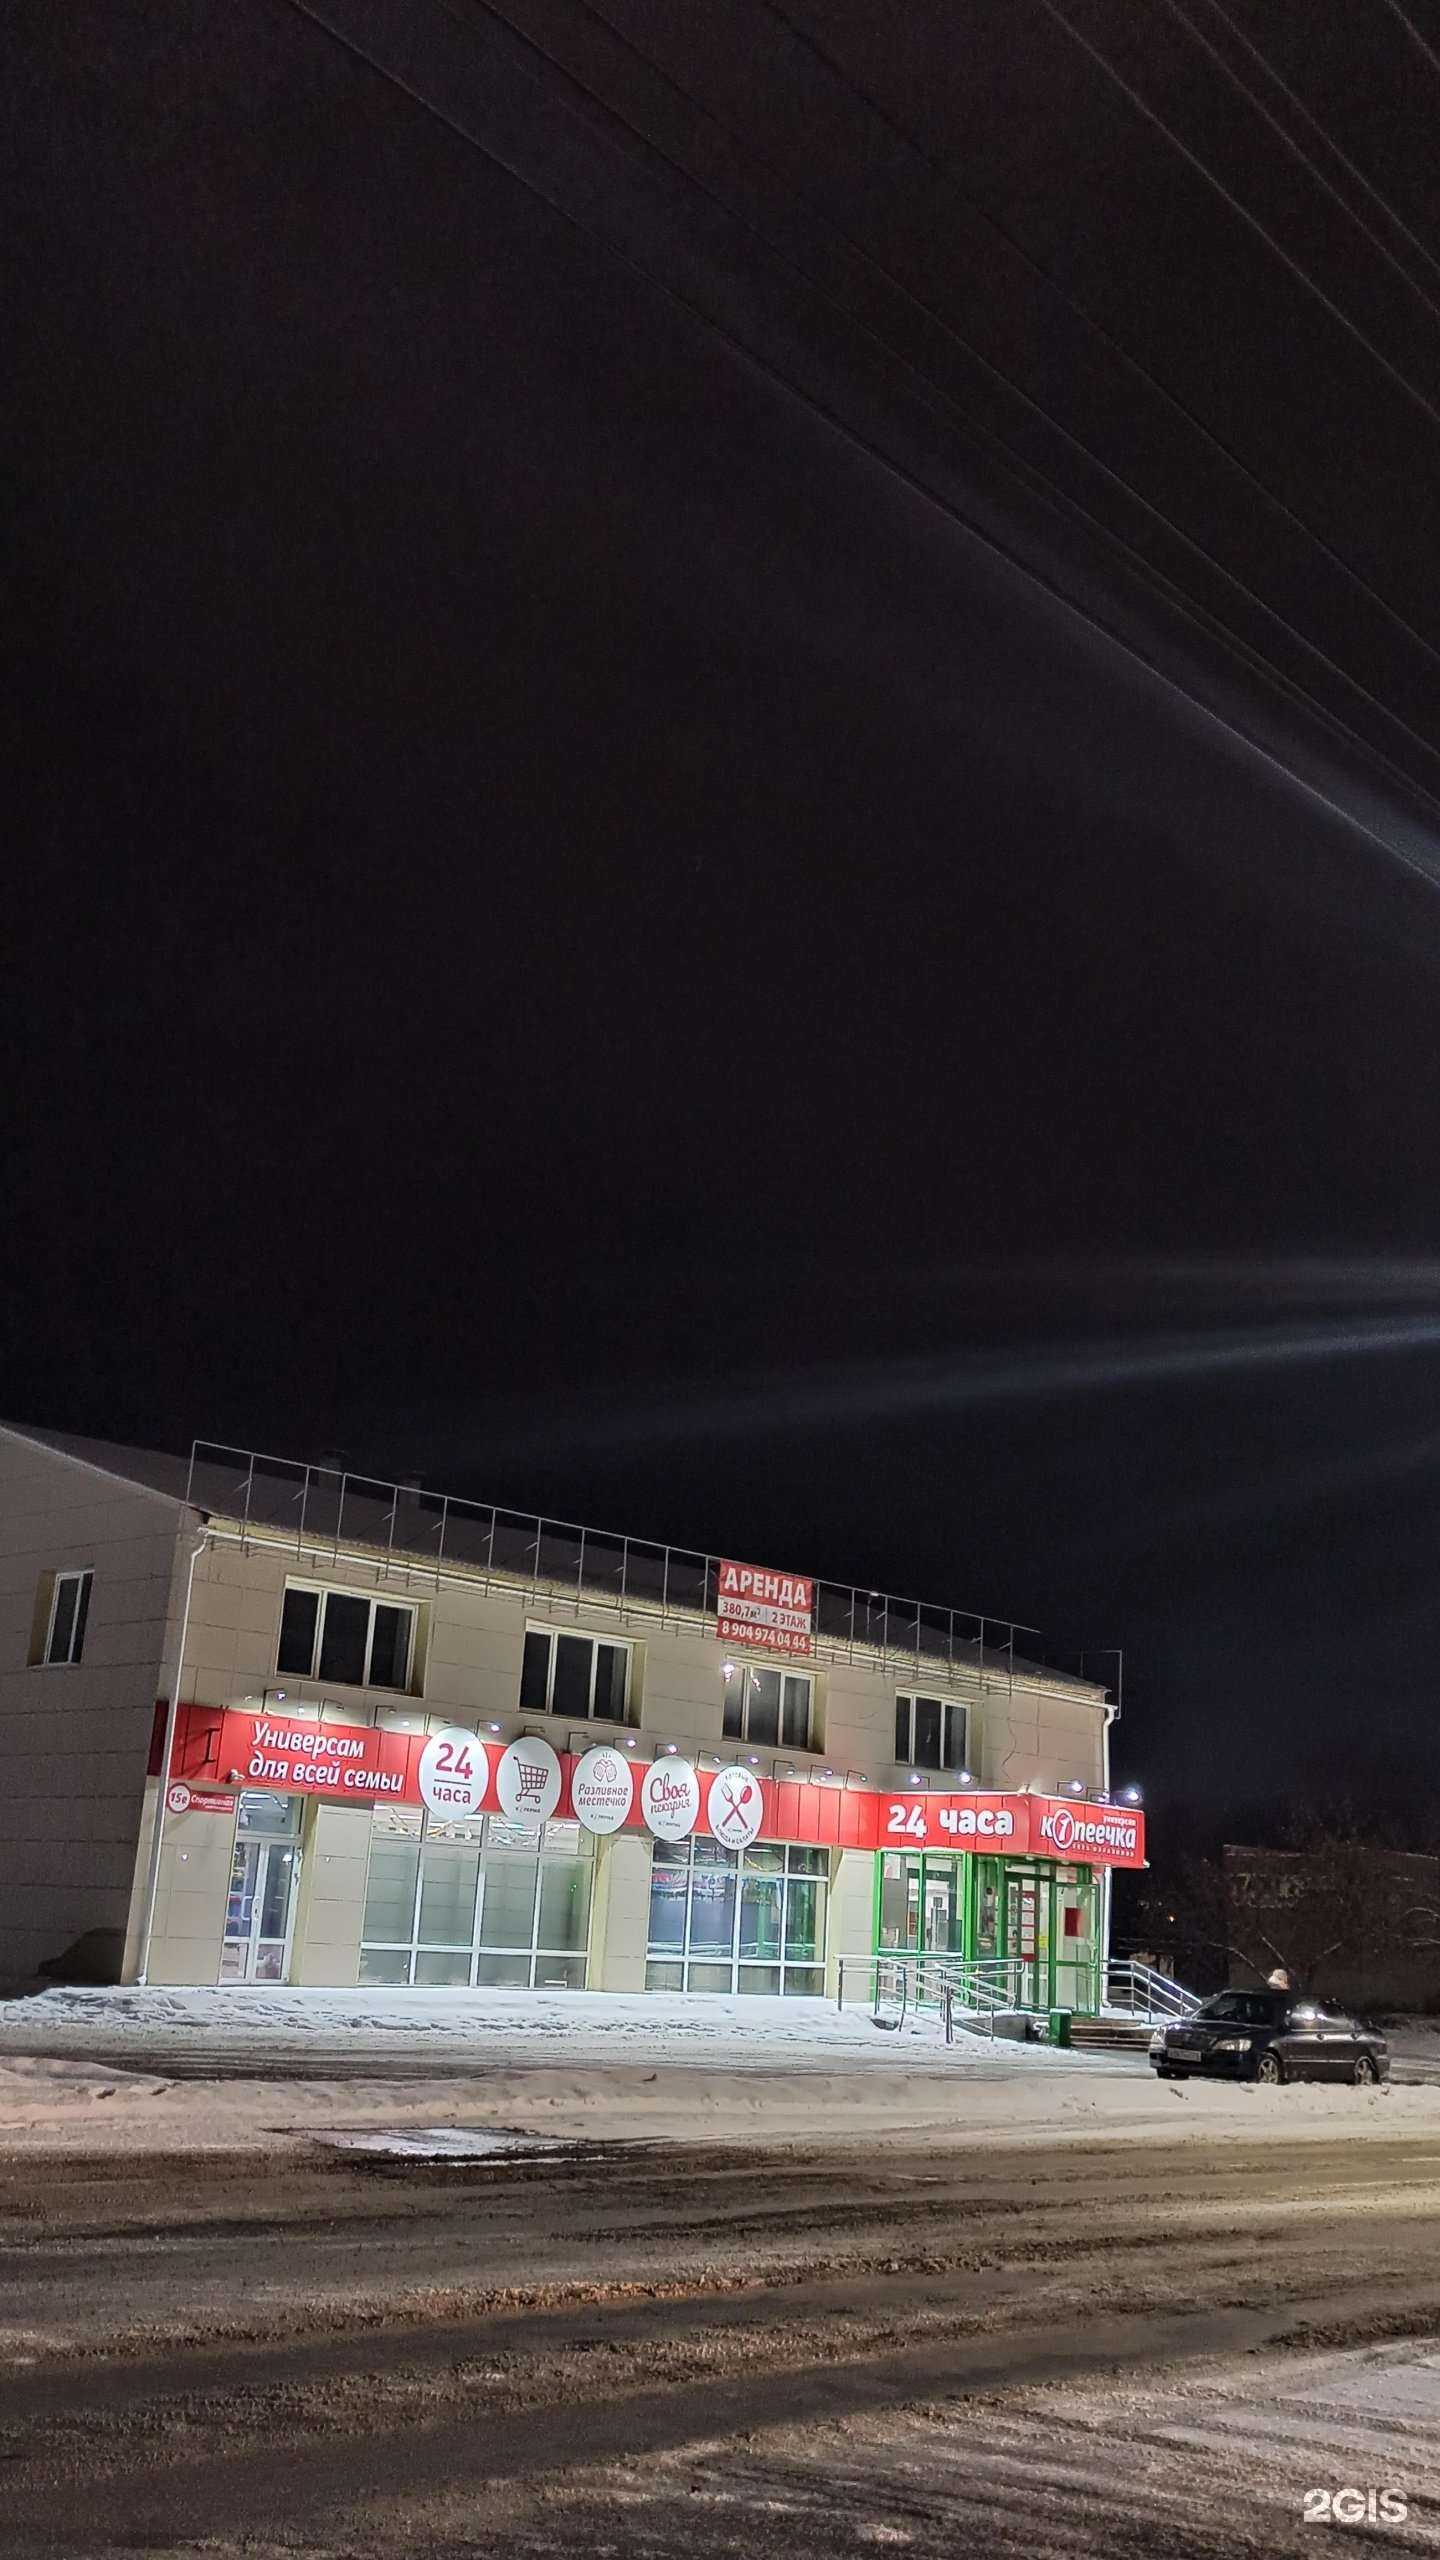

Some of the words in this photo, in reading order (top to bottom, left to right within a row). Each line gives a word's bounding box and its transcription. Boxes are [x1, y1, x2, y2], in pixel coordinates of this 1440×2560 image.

[724, 1567, 807, 1609] АРЕНДА
[722, 1620, 730, 1634] 8
[732, 1622, 753, 1640] 904
[754, 1627, 775, 1645] 974
[777, 1631, 791, 1647] 04
[792, 1634, 806, 1650] 44
[771, 1611, 779, 1623] 2
[781, 1612, 807, 1630] ЭТАЖ
[252, 1720, 364, 1760] Универсам
[249, 1751, 288, 1780] для
[292, 1761, 340, 1787] всей
[344, 1767, 404, 1793] семьи
[435, 1742, 473, 1780] 24
[433, 1786, 471, 1805] часа
[578, 1783, 628, 1797] Разливное
[578, 1796, 627, 1808] местечко
[649, 1772, 691, 1803] Своя
[887, 1804, 928, 1838] 24
[939, 1808, 1014, 1836] часа
